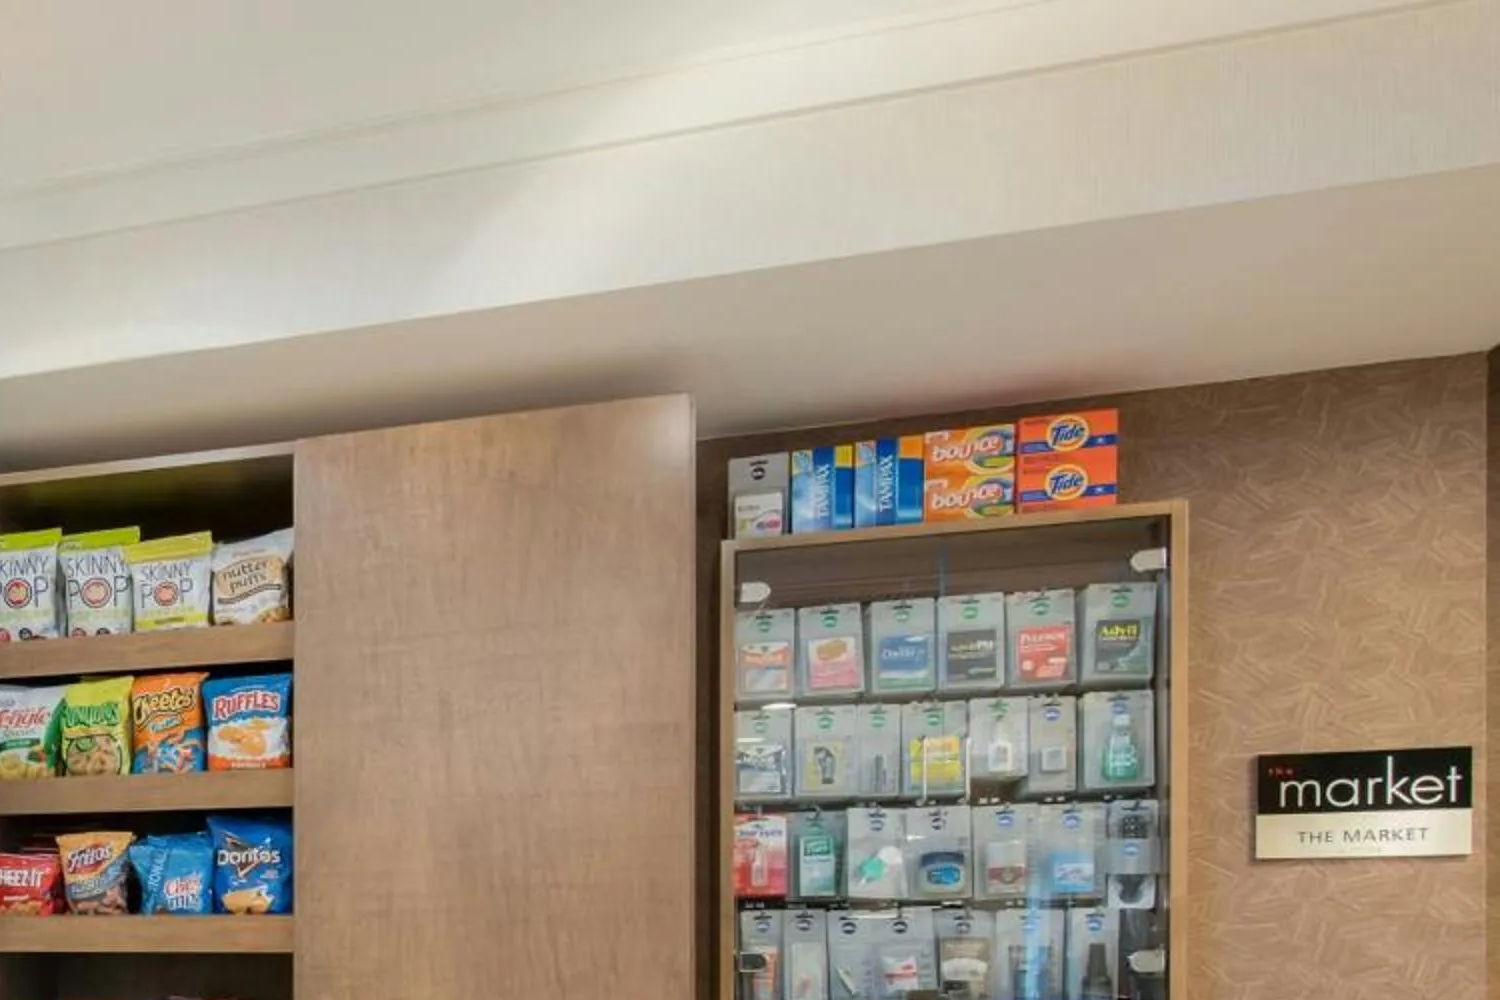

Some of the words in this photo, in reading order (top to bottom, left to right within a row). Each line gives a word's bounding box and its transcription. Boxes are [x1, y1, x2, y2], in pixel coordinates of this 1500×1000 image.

[1051, 424, 1085, 446] Tide
[932, 436, 1003, 462] bounce
[1050, 473, 1085, 494] Tide
[932, 484, 1003, 509] bounce
[67, 554, 127, 576] SKINNY
[141, 560, 193, 580] SKINNY
[68, 575, 130, 611] POP
[140, 577, 194, 608] POP
[214, 690, 280, 719] RUFFLES
[1279, 755, 1463, 808] market
[1298, 830, 1334, 844] THE
[1343, 828, 1429, 843] MARKET
[68, 843, 112, 872] Fritos
[217, 848, 281, 866] Doritos
